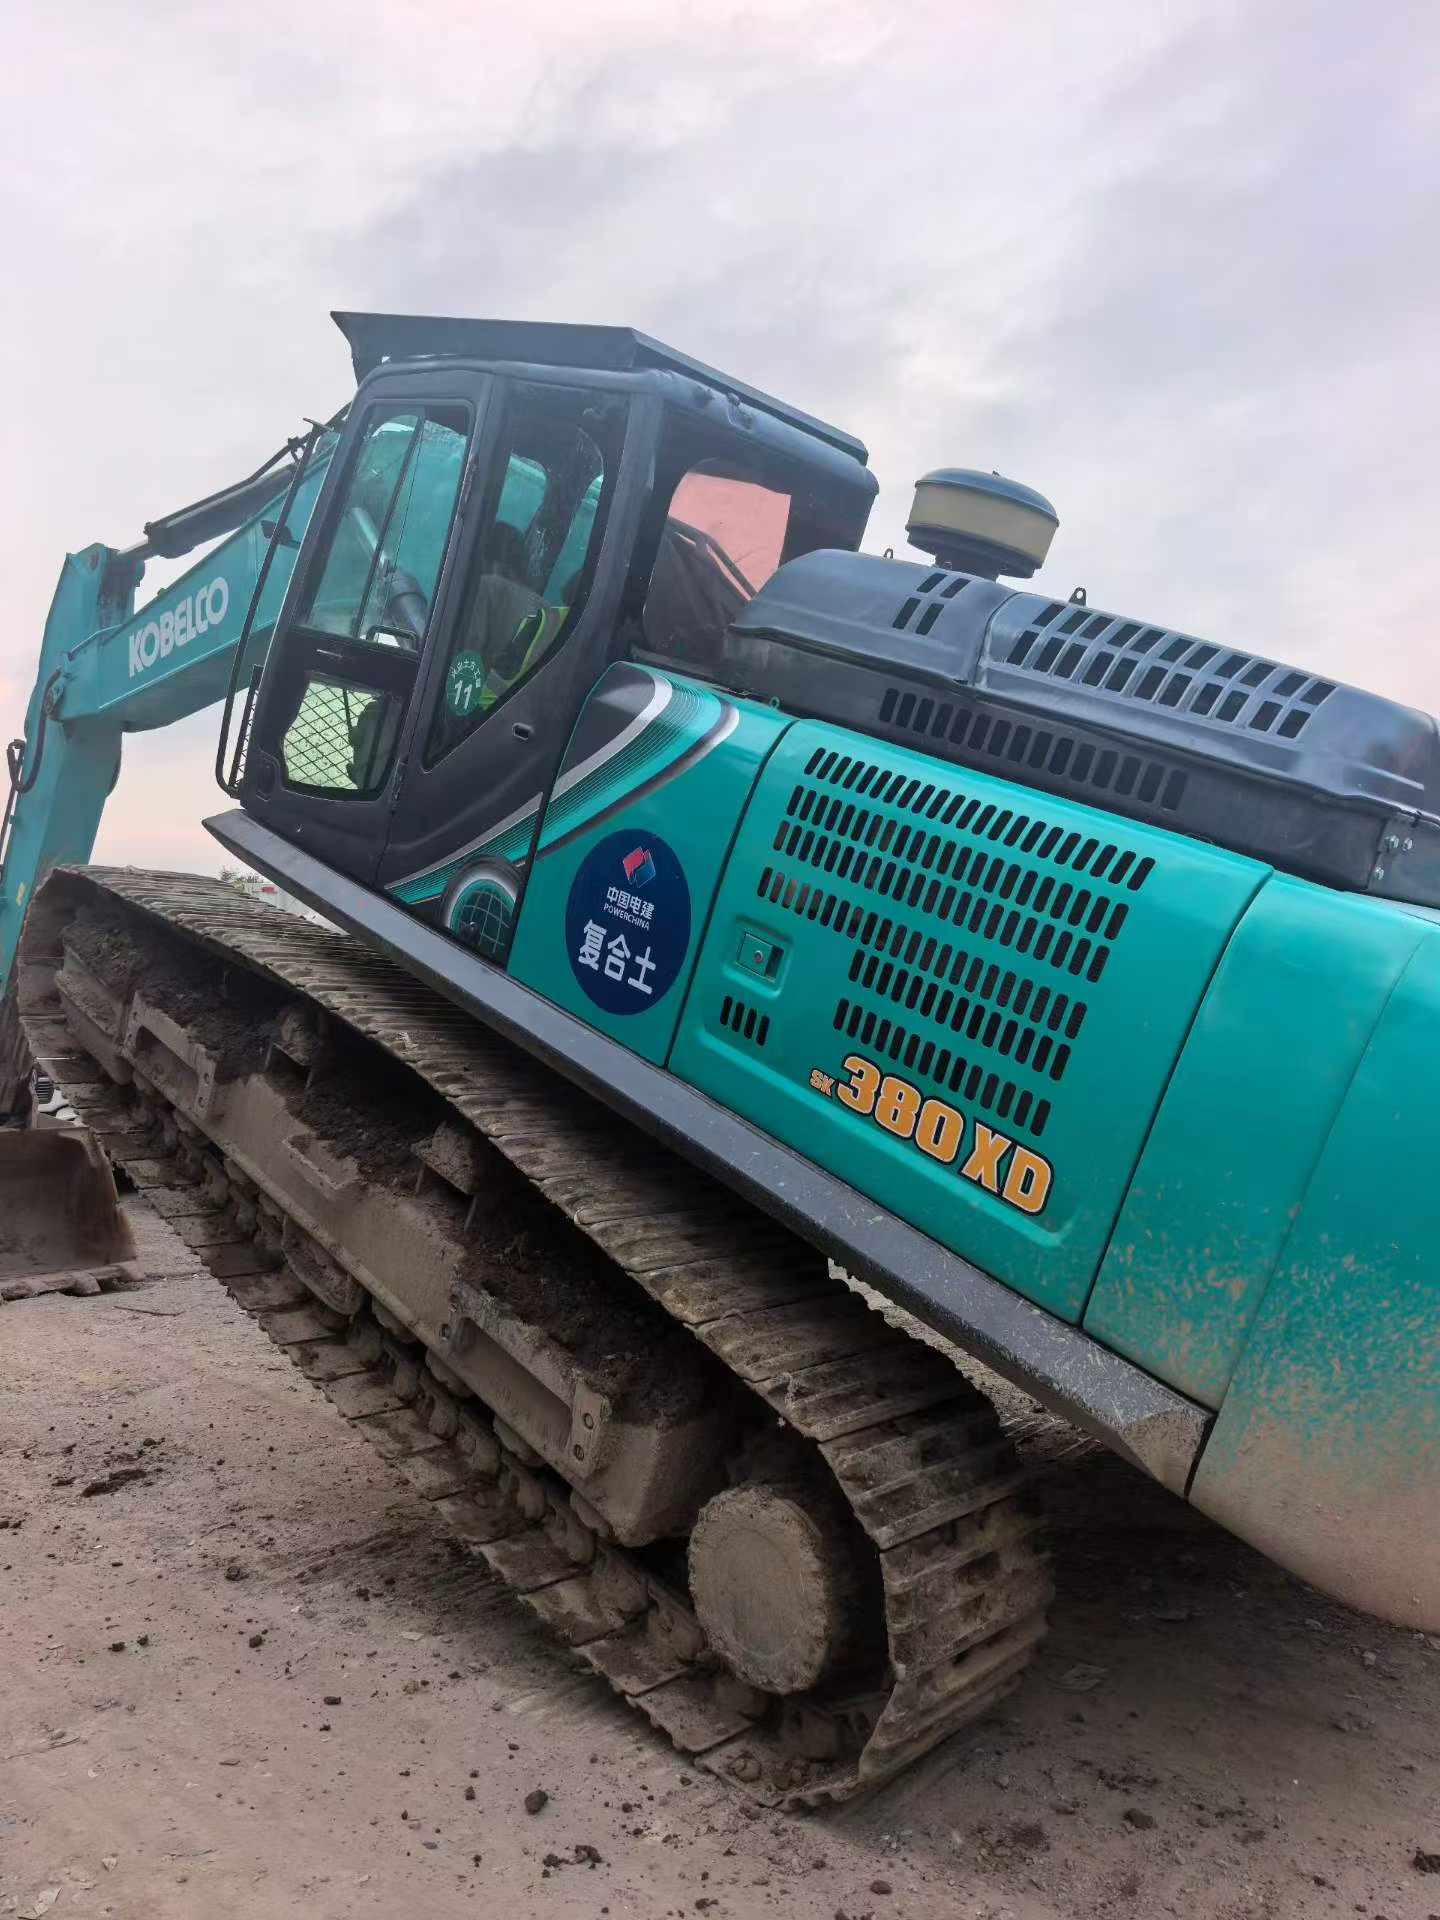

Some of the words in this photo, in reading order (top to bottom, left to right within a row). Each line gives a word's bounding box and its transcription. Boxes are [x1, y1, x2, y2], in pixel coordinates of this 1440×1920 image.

[128, 577, 229, 678] KOBELCO
[454, 679, 473, 710] 11
[603, 903, 650, 931] POWERCHINA
[606, 886, 655, 920] 中国电建
[578, 919, 656, 995] 复合土
